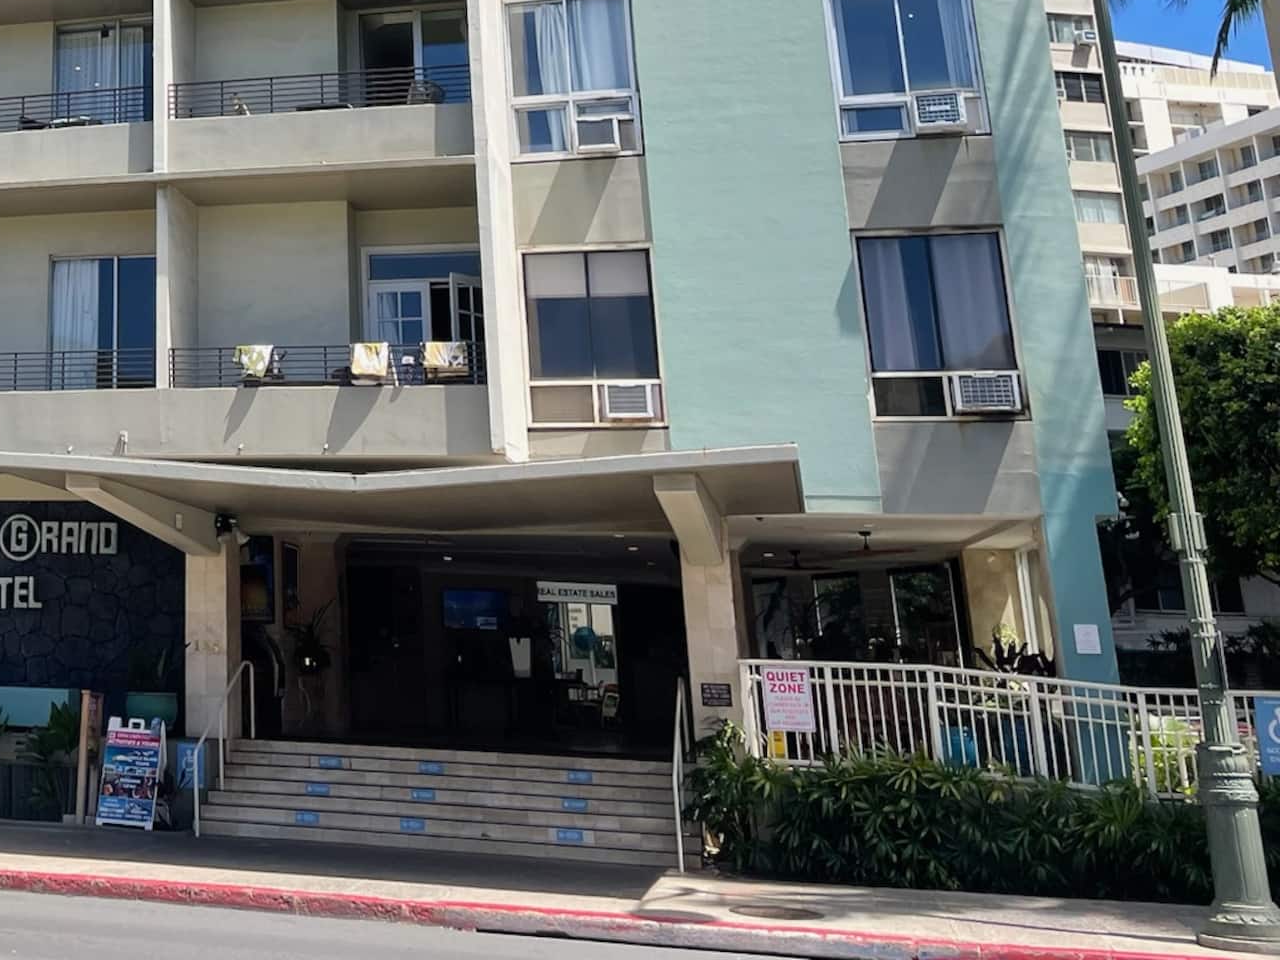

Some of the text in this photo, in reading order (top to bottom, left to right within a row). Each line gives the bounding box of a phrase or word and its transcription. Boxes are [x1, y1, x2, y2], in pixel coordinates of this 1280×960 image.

[0, 515, 117, 560] GRAND
[558, 589, 587, 597] ESTATE
[590, 590, 615, 598] SALES
[766, 671, 806, 682] QUIET
[769, 683, 806, 694] ZONE
